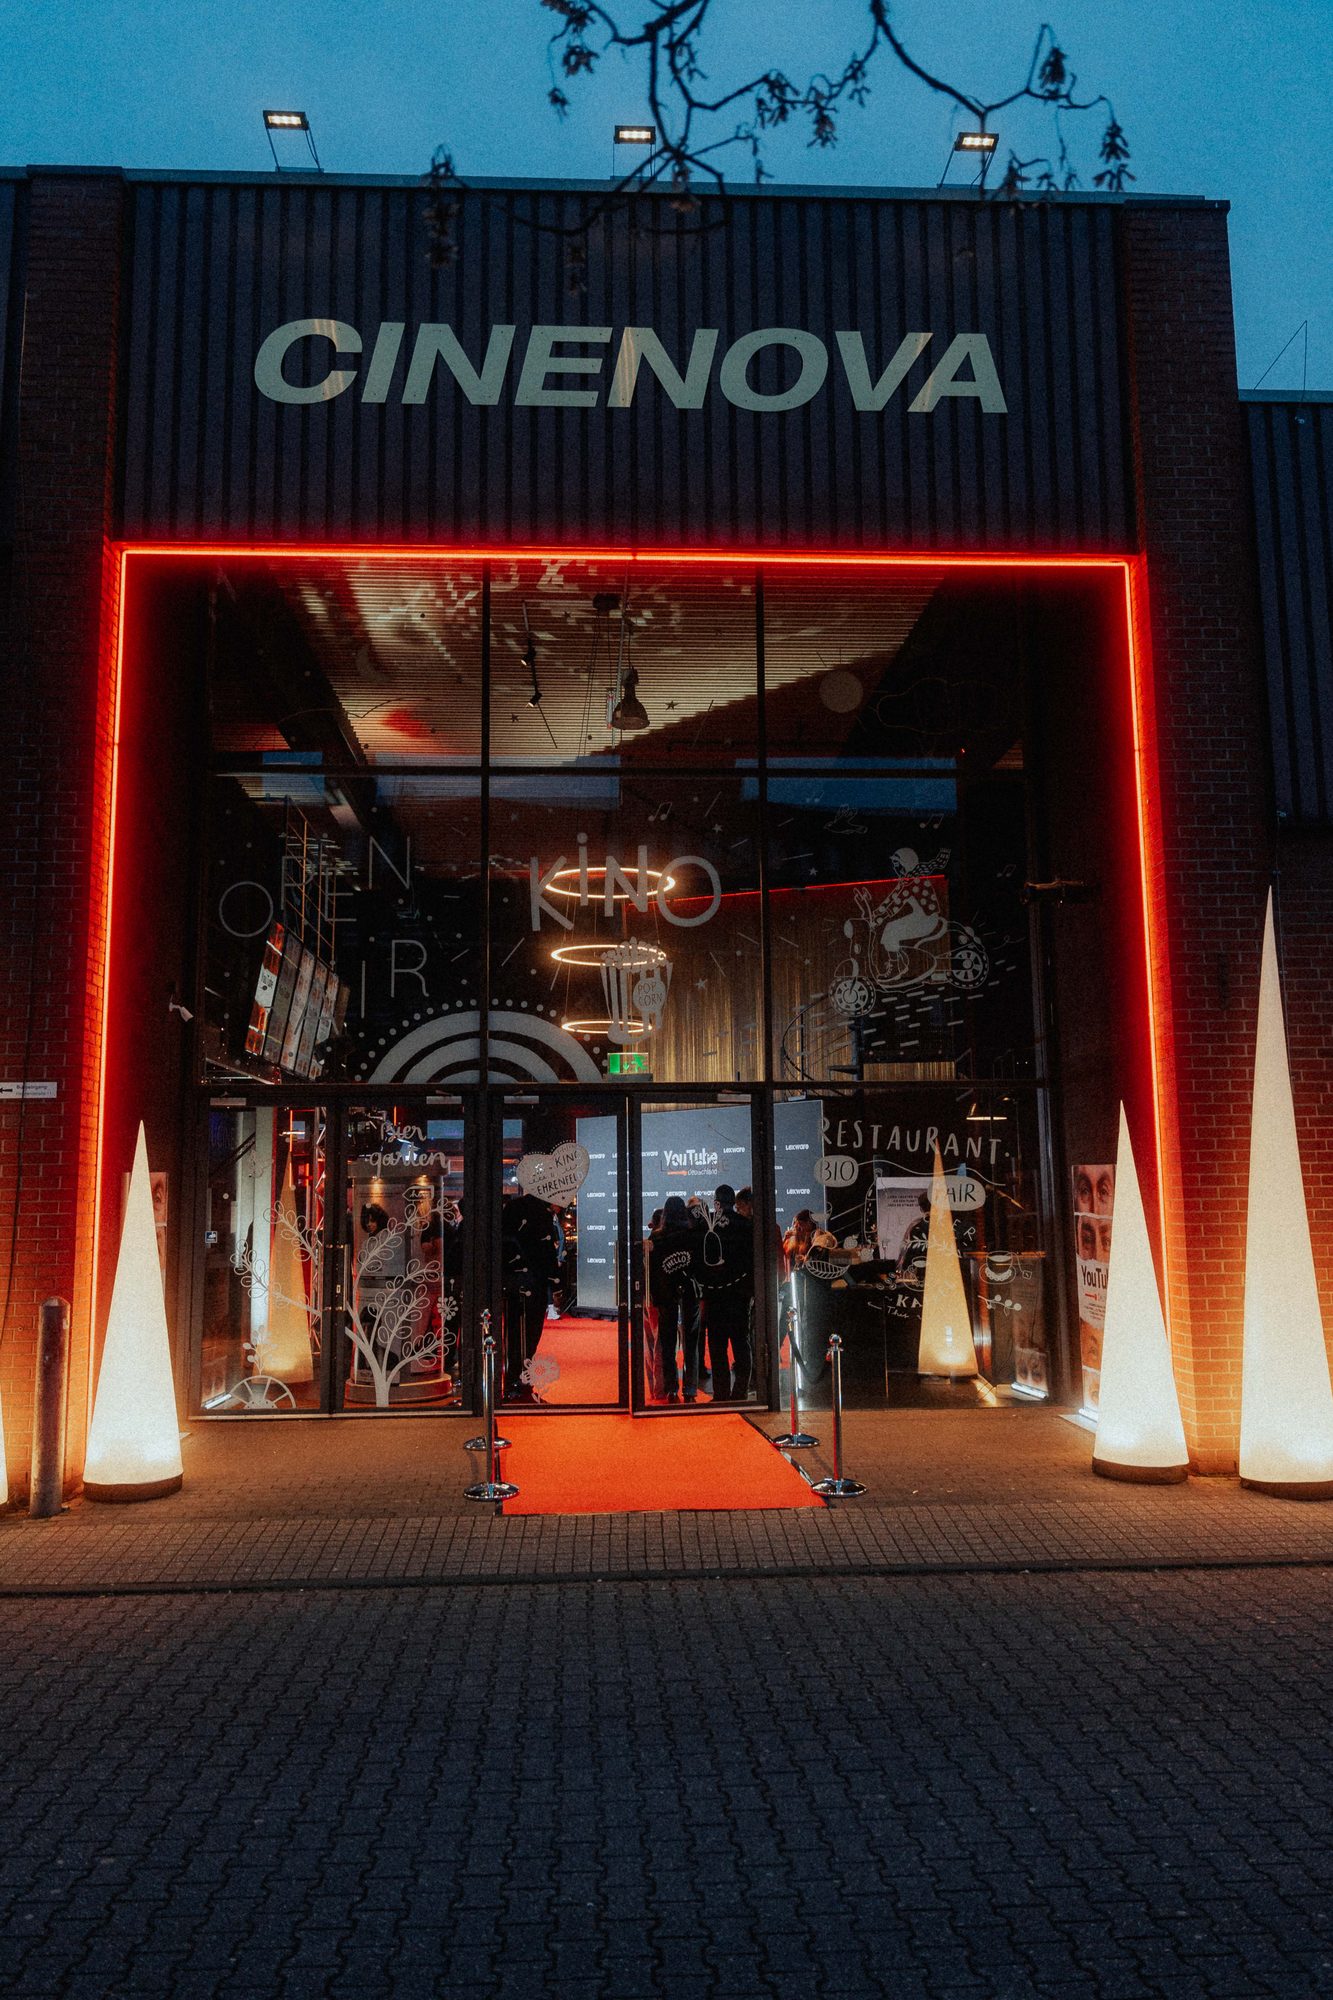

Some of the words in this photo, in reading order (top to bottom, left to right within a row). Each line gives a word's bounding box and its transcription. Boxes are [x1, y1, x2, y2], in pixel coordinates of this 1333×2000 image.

[253, 318, 1008, 414] CINENOVA
[218, 834, 411, 938] OPEN
[637, 982, 657, 994] POP
[638, 993, 664, 1007] CORN
[663, 1147, 718, 1167] YouTube
[785, 1143, 810, 1151] Lexware
[369, 1142, 450, 1180] garten
[821, 1160, 855, 1182] BIO
[665, 1255, 687, 1270] HELLO
[1081, 1264, 1109, 1290] YouTu
